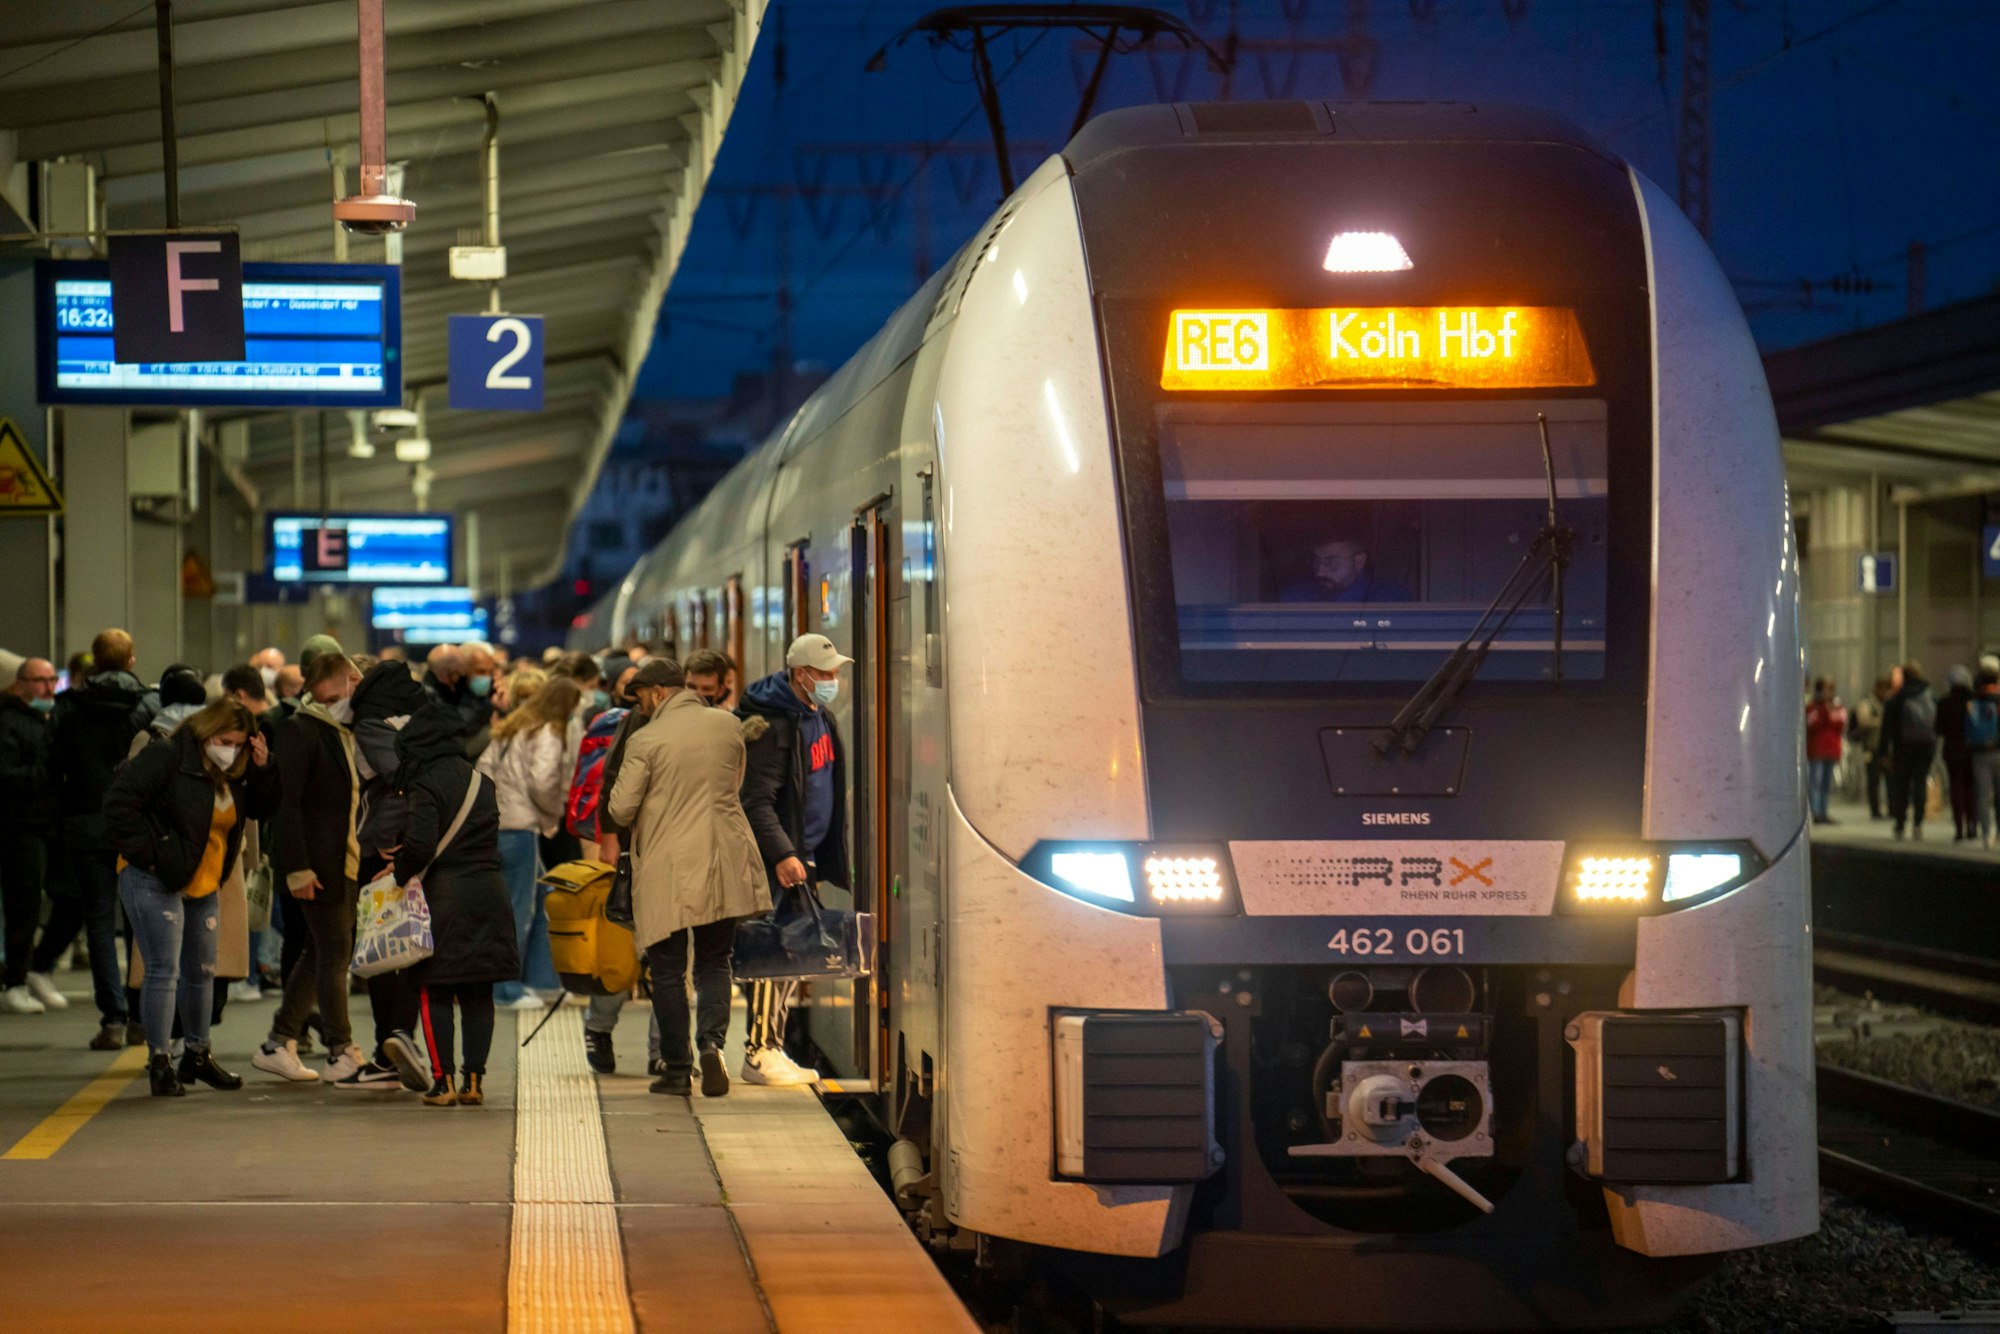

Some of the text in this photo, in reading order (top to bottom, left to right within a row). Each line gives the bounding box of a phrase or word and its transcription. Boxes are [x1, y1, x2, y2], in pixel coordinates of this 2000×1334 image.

[166, 241, 221, 333] F
[58, 308, 107, 328] 16:32
[486, 318, 532, 389] 2
[1182, 311, 1517, 365] RE6 Köln Hbf
[317, 529, 344, 567] E
[1361, 812, 1431, 825] SIEMENS
[1400, 891, 1527, 900] RHEIN RUHR XPRESS
[1327, 928, 1465, 955] 462 061
